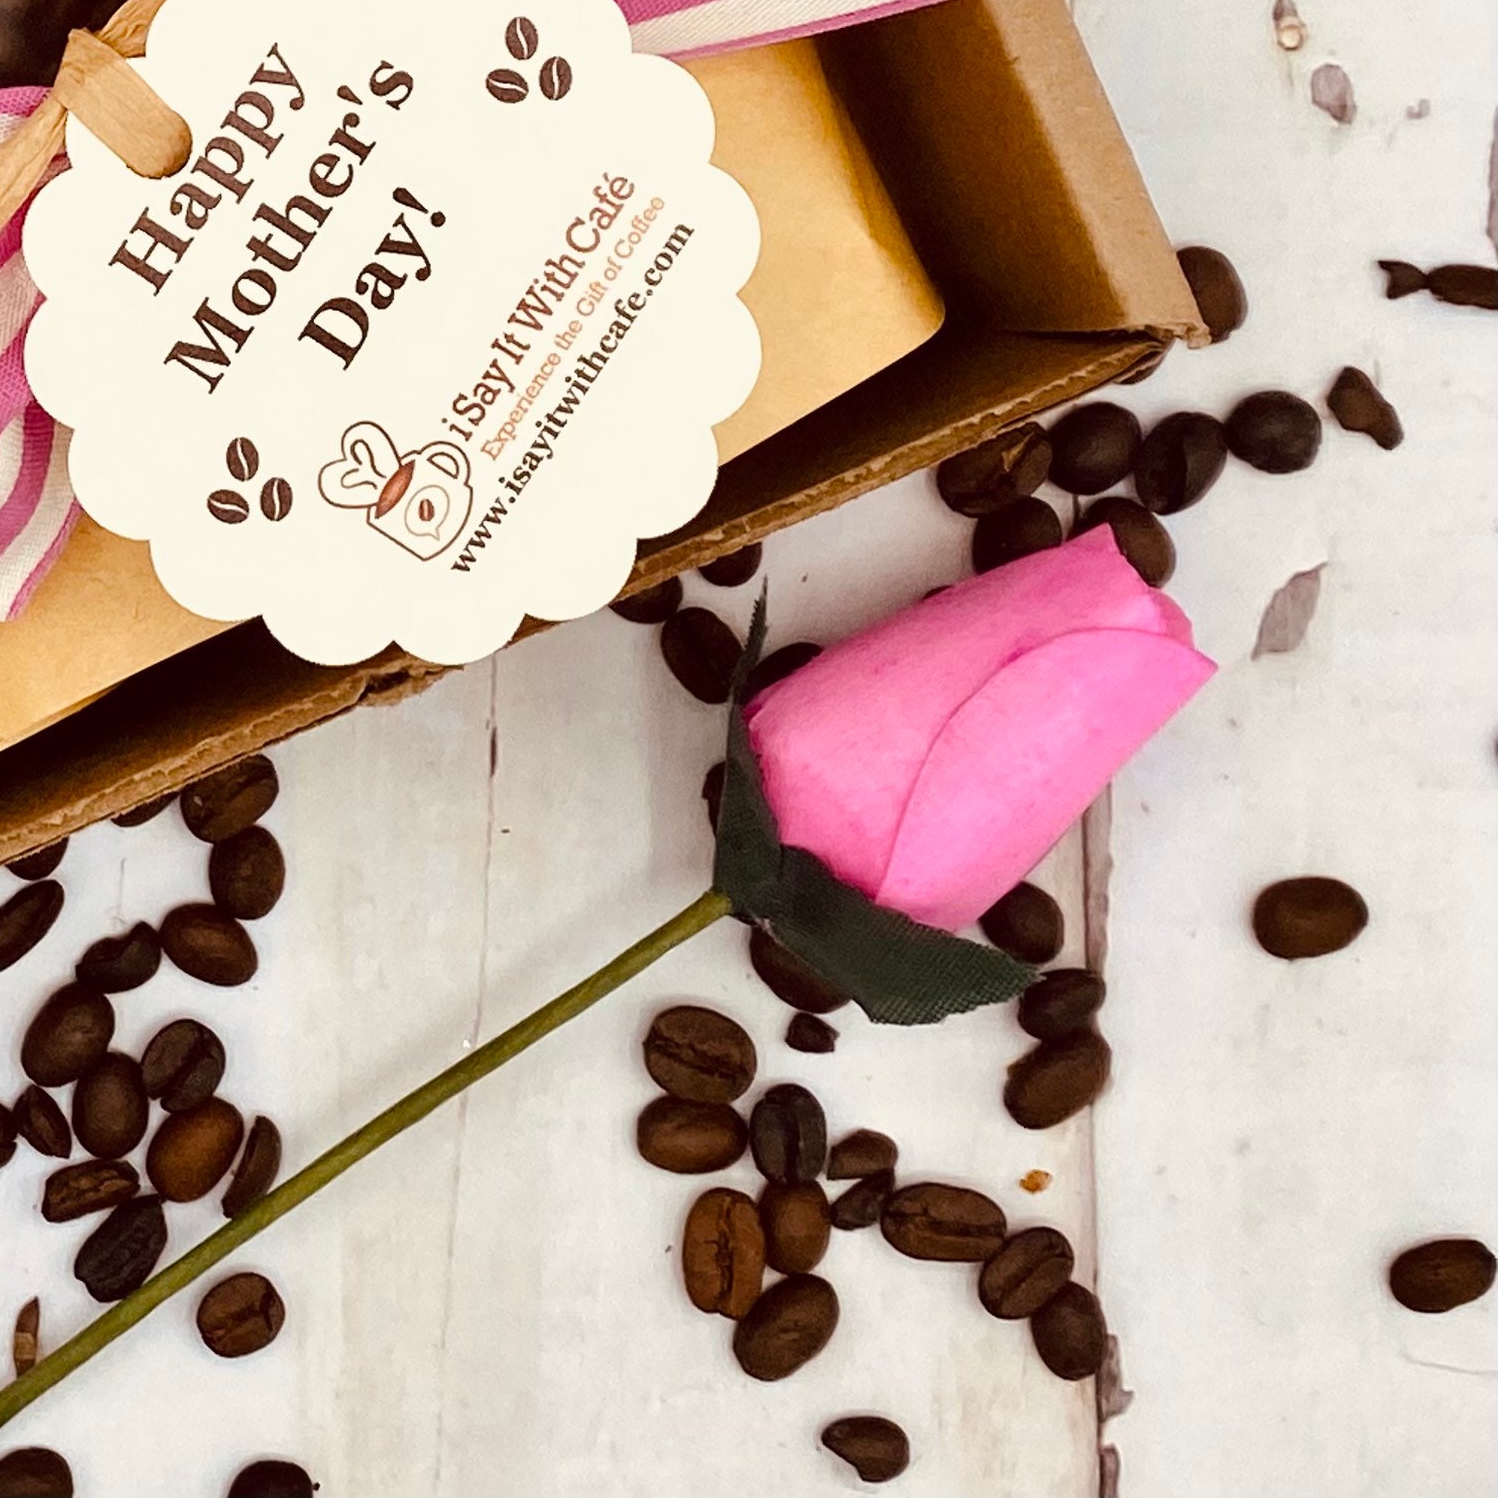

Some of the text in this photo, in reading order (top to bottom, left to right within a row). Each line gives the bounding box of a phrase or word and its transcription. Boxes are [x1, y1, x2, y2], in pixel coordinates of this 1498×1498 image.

[107, 42, 306, 296] Happy
[162, 60, 414, 394] Mother's
[297, 186, 446, 371] Day!
[450, 222, 695, 572] www.isayitwithcafe.com
[479, 196, 665, 461] Experience the Gift of Coffee
